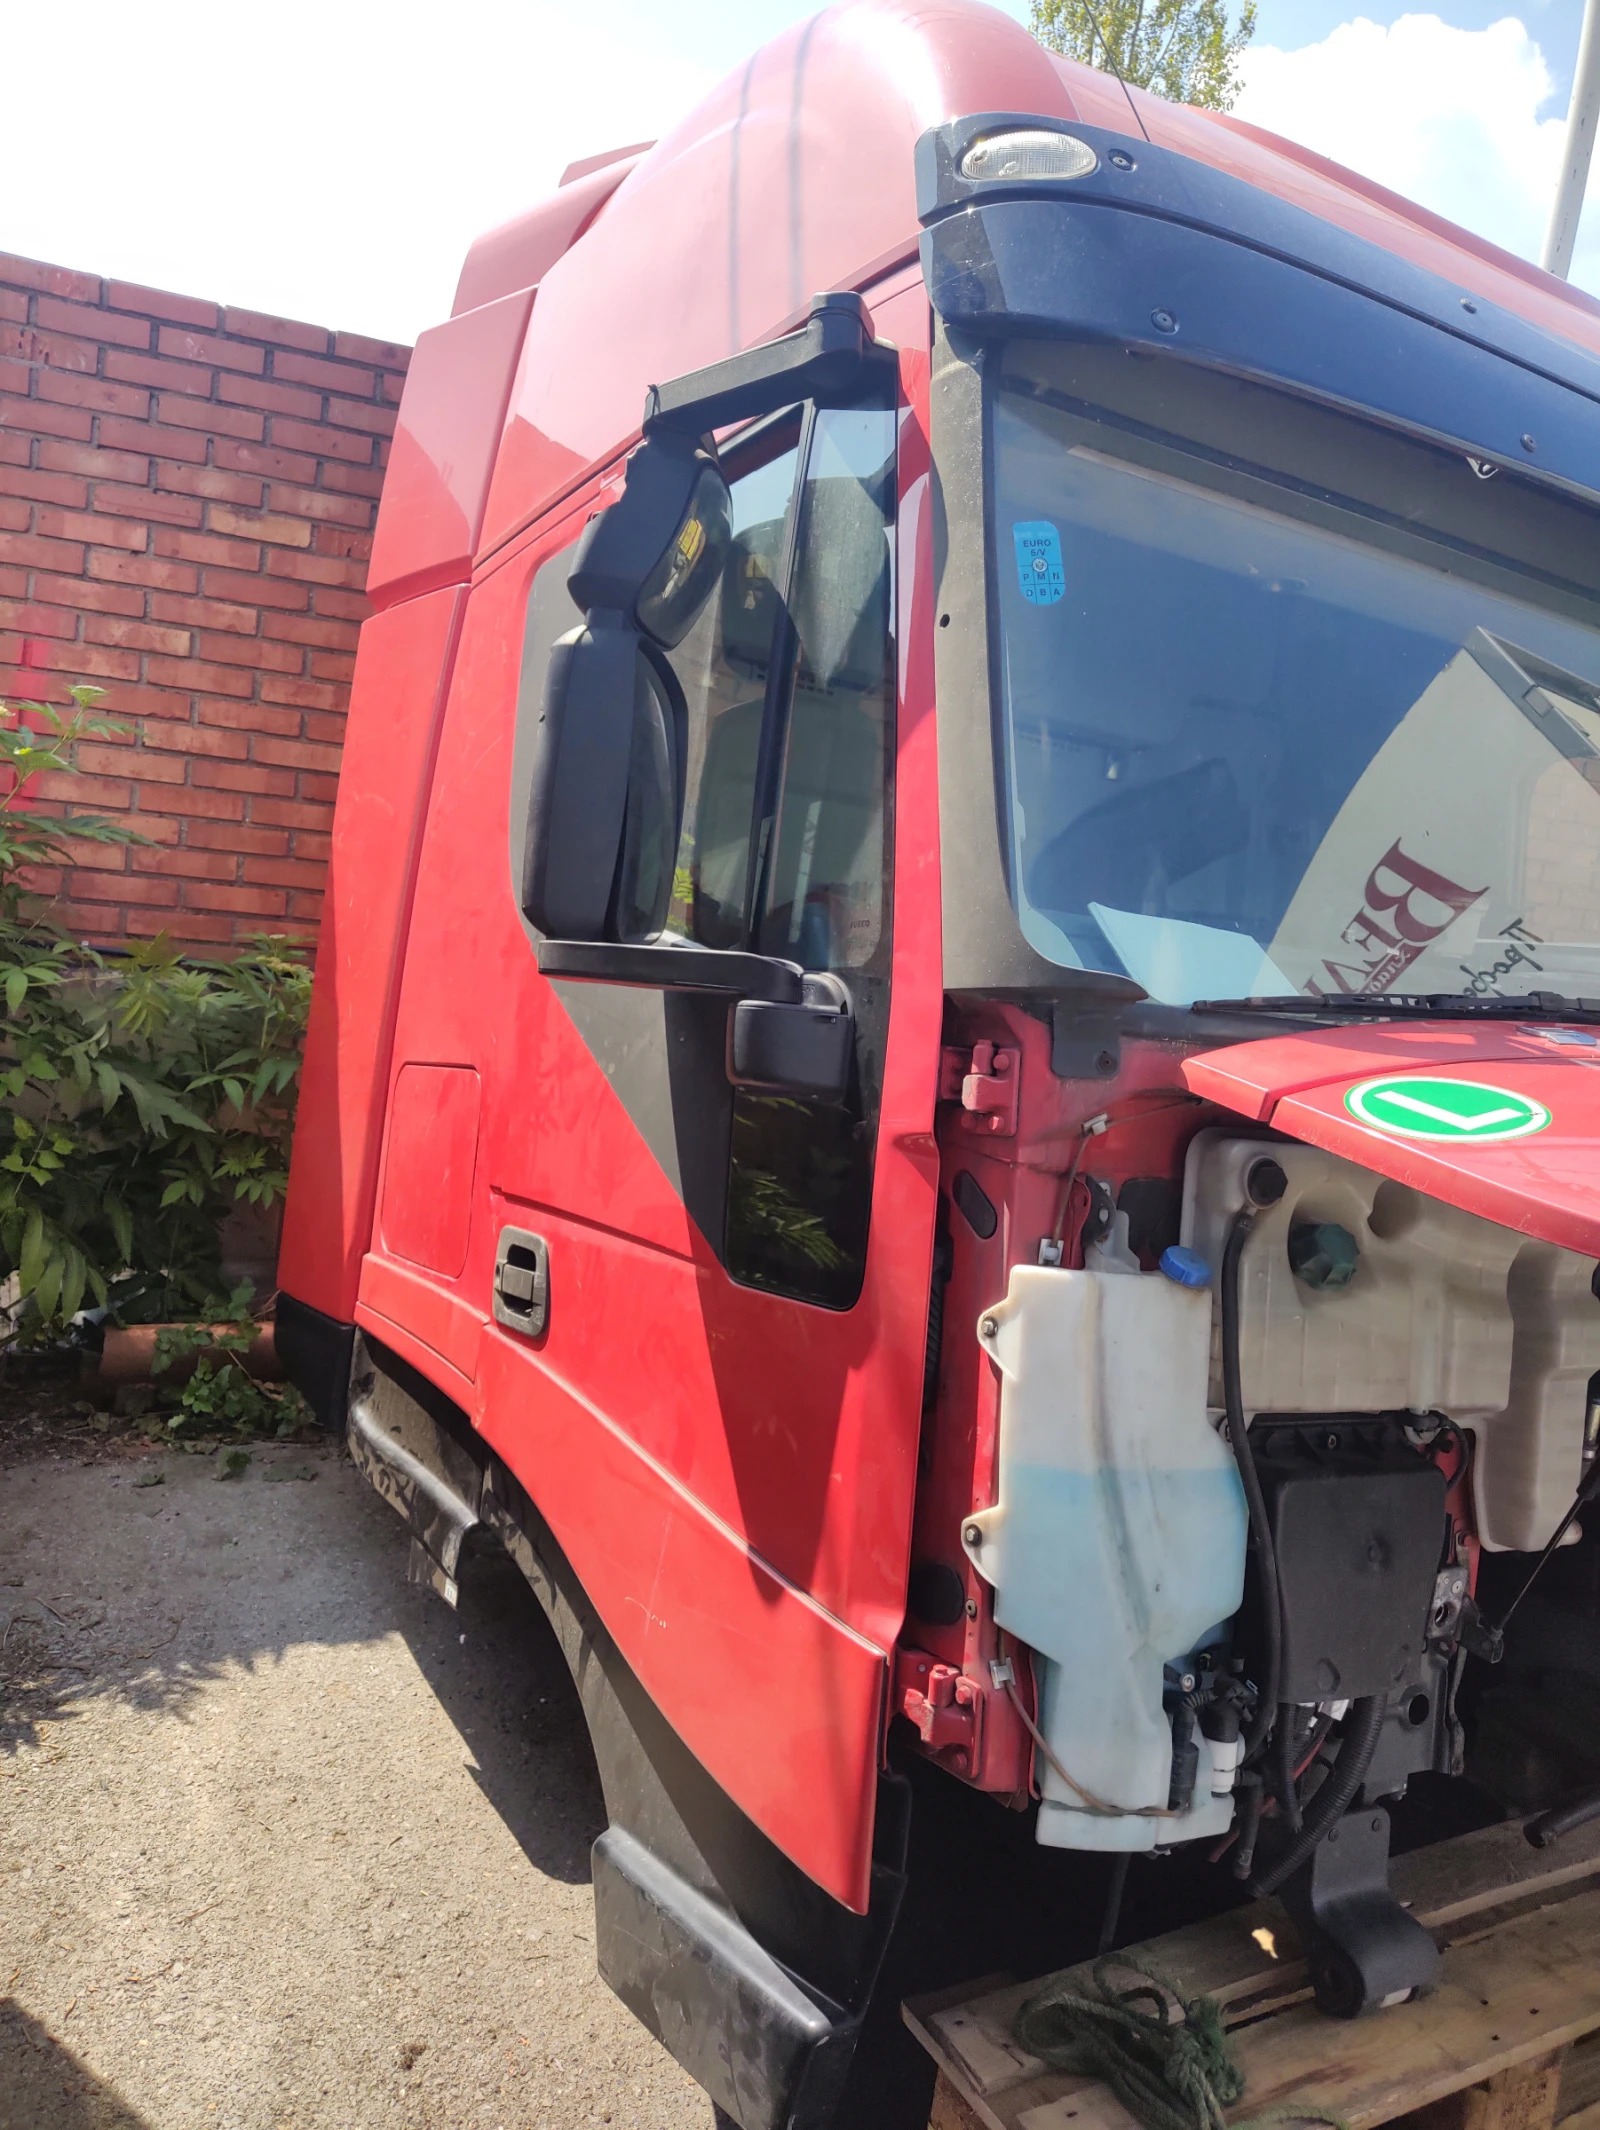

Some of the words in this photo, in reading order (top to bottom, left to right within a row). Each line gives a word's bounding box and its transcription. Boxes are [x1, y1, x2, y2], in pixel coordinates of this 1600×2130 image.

[1023, 539, 1052, 548] EURO
[1037, 572, 1046, 581] M
[1040, 587, 1047, 596] B
[1053, 587, 1060, 595] A
[850, 919, 871, 929] IVECO
[1373, 1089, 1526, 1132] L
